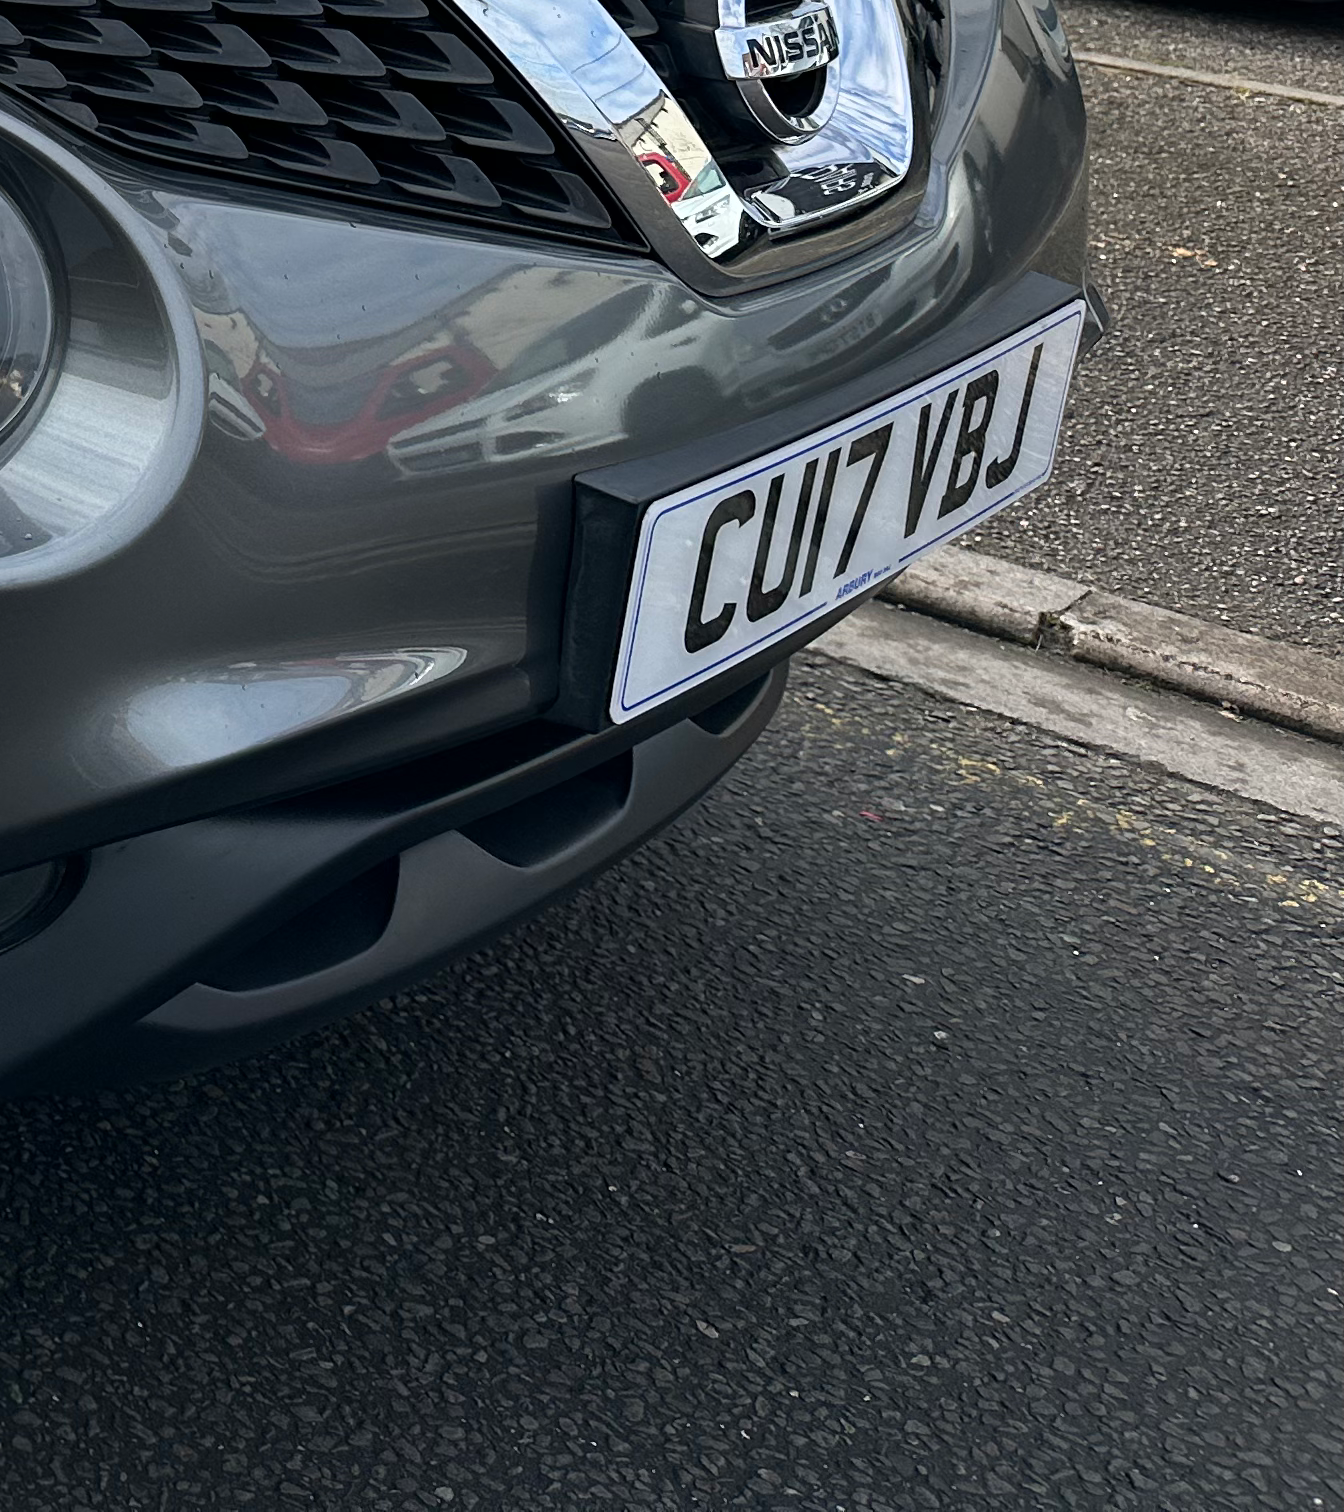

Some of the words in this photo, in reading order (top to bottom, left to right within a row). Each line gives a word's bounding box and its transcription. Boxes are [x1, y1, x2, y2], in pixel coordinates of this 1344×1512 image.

[746, 13, 840, 69] NISSAN
[684, 421, 895, 655] CU17
[904, 342, 1044, 539] VBJ
